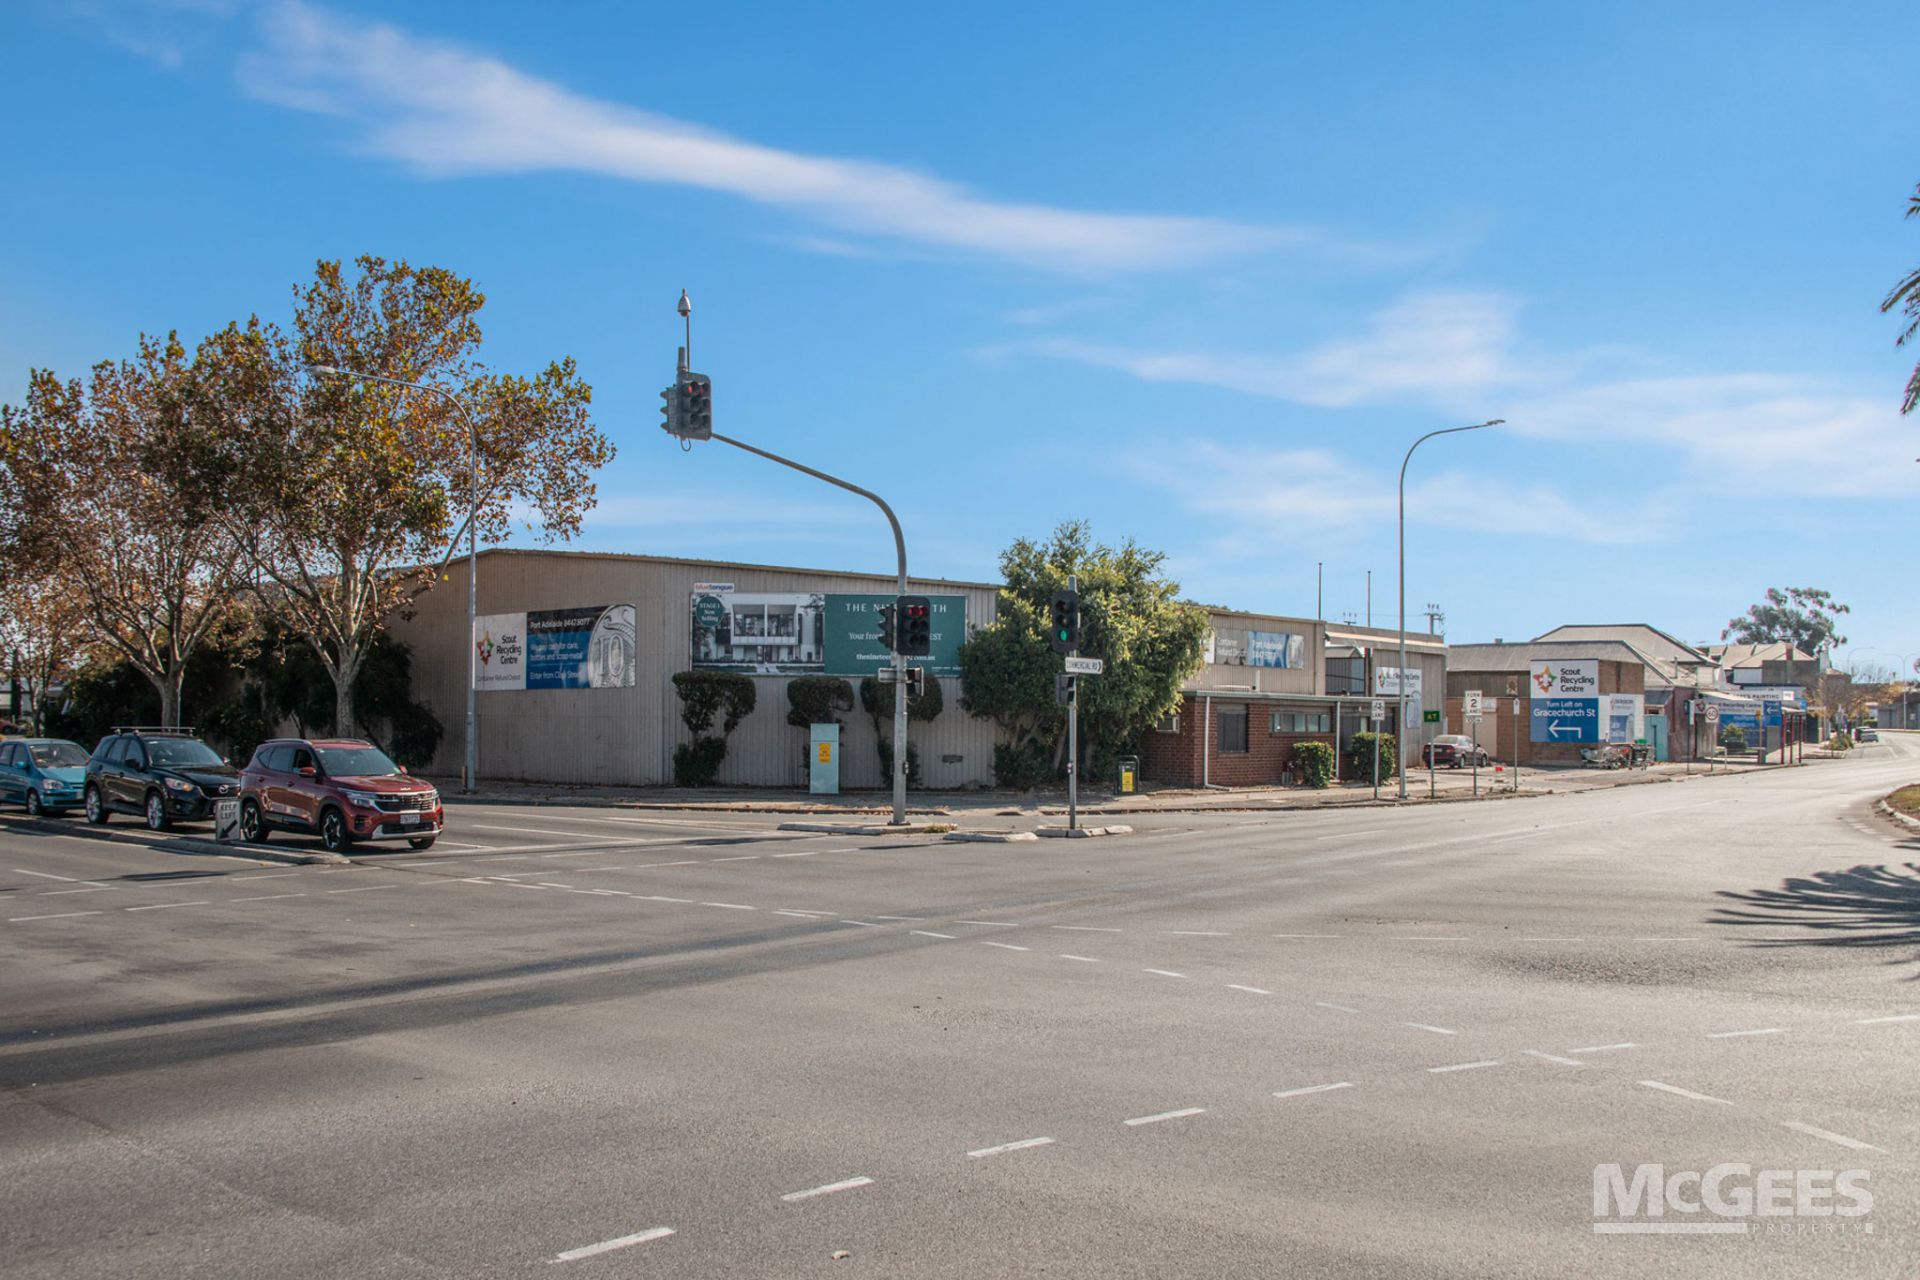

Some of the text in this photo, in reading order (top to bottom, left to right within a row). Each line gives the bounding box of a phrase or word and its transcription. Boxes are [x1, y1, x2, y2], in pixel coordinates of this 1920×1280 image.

[846, 603, 867, 612] THE
[501, 634, 517, 644] Scout
[848, 632, 863, 640] Your
[496, 645, 522, 656] Recycling
[500, 656, 518, 665] Centre
[1560, 668, 1581, 676] Scout
[1560, 676, 1595, 686] Recycling
[1471, 698, 1478, 708] 2
[1533, 708, 1596, 717] Gracechurch St
[221, 803, 238, 811] KEEP
[221, 811, 236, 820] LEFT
